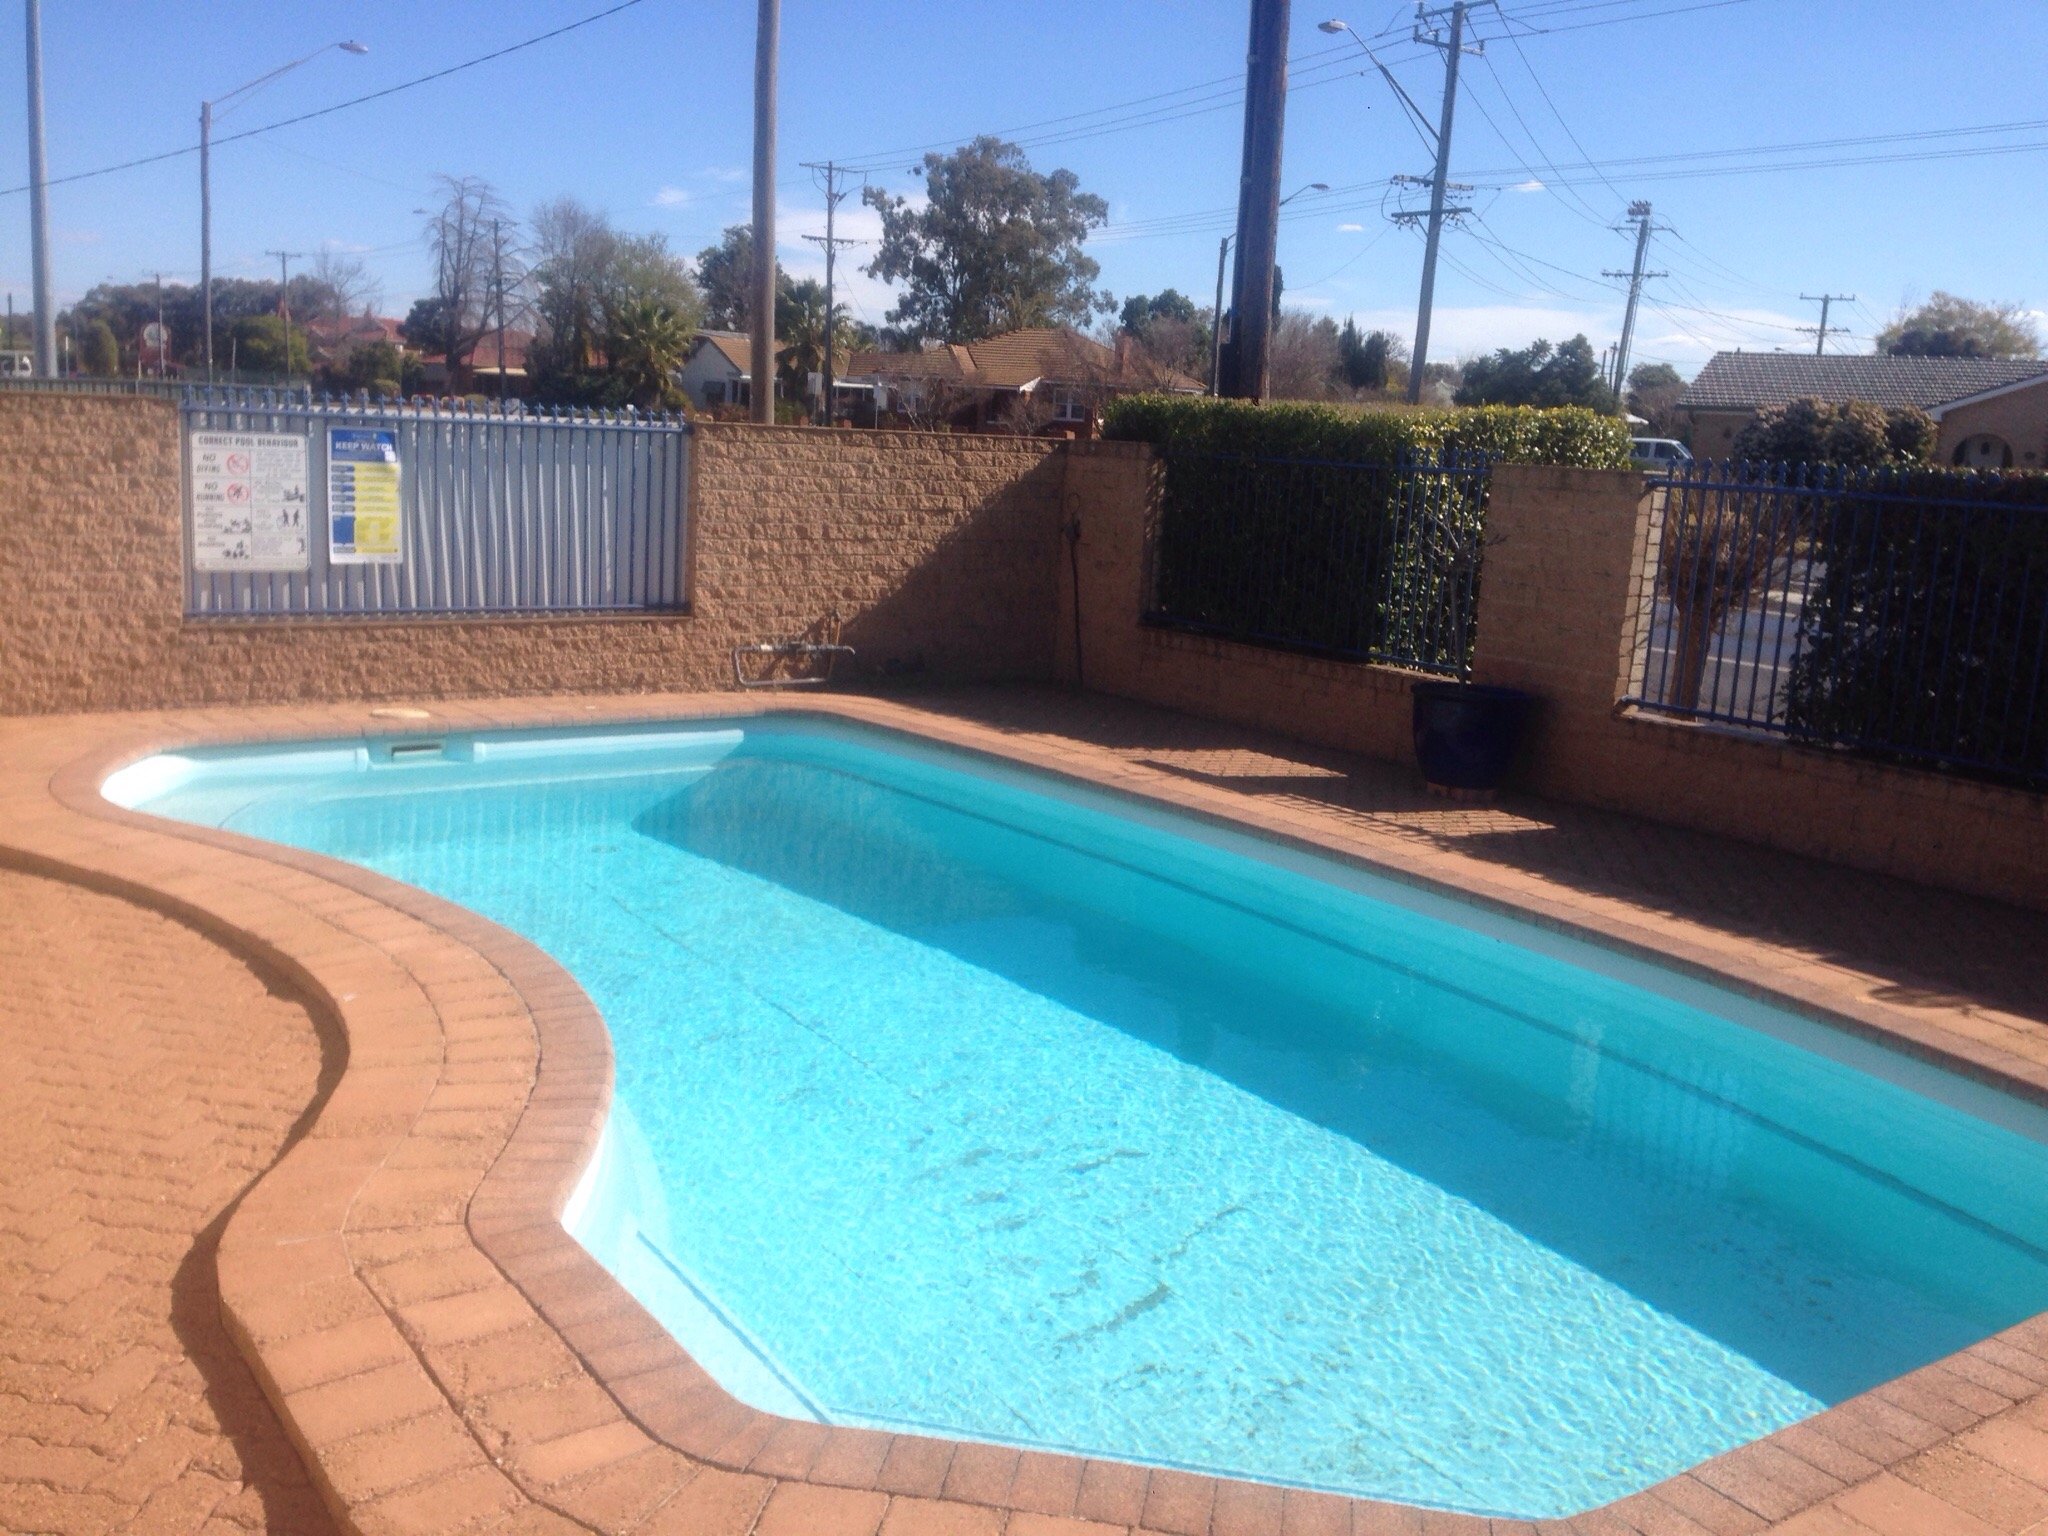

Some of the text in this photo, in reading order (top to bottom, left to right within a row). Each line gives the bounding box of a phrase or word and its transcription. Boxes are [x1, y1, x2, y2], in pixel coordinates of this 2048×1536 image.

[198, 435, 299, 447] CORRECT POOL BEHAVIOUR
[335, 441, 393, 452] KEEP WATCH
[202, 453, 216, 462] NO
[196, 465, 221, 473] DIVING
[204, 482, 218, 490] NO
